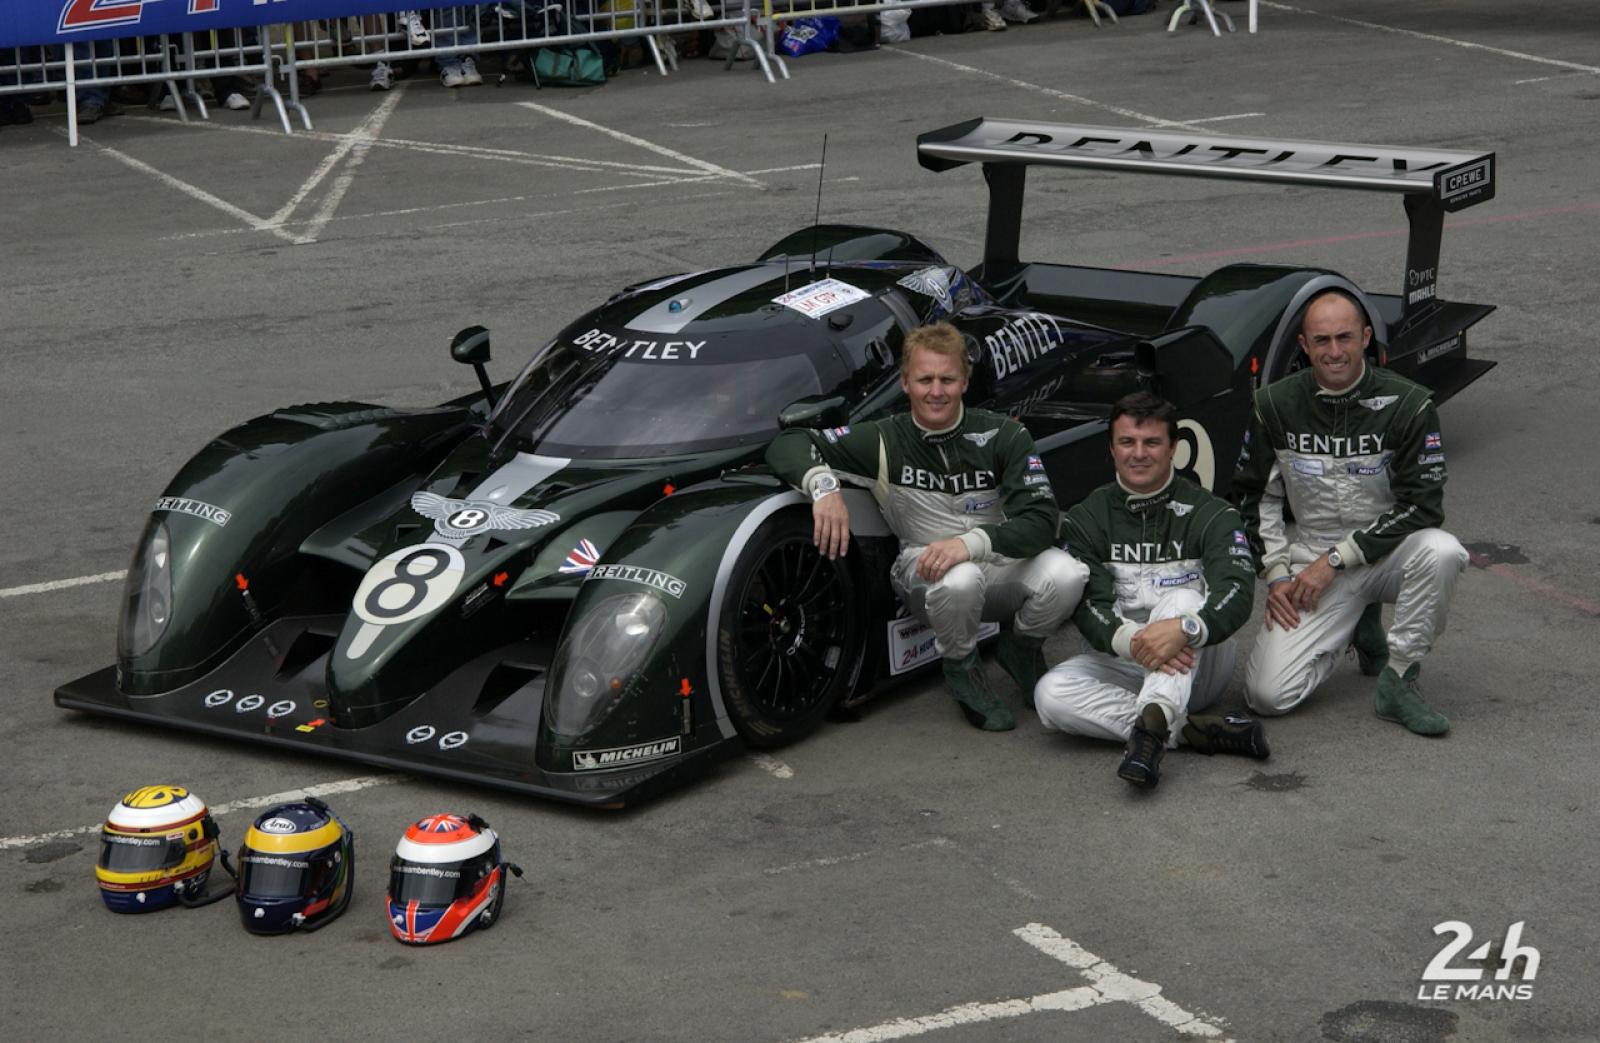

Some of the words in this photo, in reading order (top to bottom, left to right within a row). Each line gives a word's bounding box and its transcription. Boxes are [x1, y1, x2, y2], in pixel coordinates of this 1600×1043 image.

[1449, 168, 1482, 189] CREWE
[1409, 284, 1436, 304] MAHLE
[573, 328, 707, 360] BENTLEY
[985, 312, 1064, 380] BENTLEY
[1286, 432, 1386, 457] BENTLEY
[365, 548, 451, 618] 8
[600, 740, 677, 763] MICHELIN
